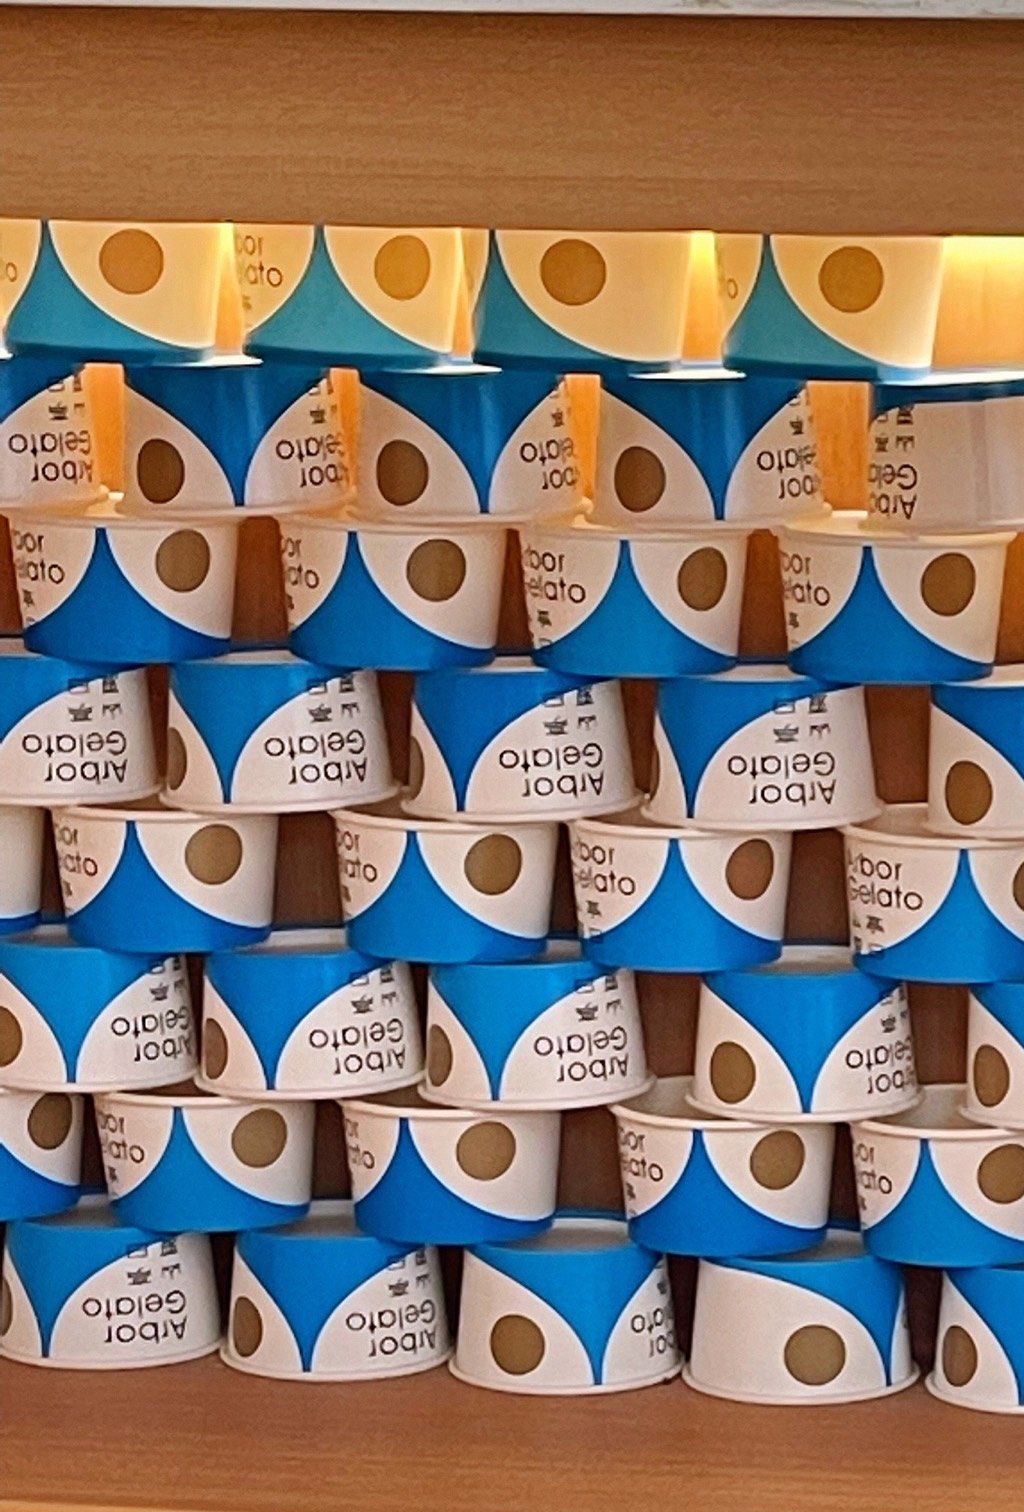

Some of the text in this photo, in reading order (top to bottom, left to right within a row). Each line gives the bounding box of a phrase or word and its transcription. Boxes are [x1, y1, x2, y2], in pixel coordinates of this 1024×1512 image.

[757, 446, 816, 474] elato
[300, 464, 343, 488] bor
[779, 476, 816, 500] bor
[870, 494, 917, 519] Arb
[17, 557, 65, 584] ato
[527, 549, 564, 572] bor
[786, 579, 830, 606] ato
[21, 731, 126, 758] Gelato
[265, 730, 366, 759] Gelato
[499, 743, 603, 773] Gelato
[44, 759, 127, 785] Arbor
[289, 757, 368, 786] Arbor
[728, 752, 835, 780] Gelato
[522, 771, 604, 798] Arbor
[749, 780, 837, 806] Arbor
[577, 841, 614, 866] bor
[112, 1006, 189, 1038] Gelato
[309, 1018, 404, 1051] Gelato
[534, 1026, 628, 1058] Gelato
[334, 1048, 405, 1075] Arbor
[557, 1054, 629, 1082] Arbor
[868, 1070, 908, 1095] bor
[83, 1290, 186, 1321] Gelato
[346, 1299, 436, 1334] Gelato
[104, 1317, 187, 1343] Arbor
[368, 1329, 436, 1357] Arbor
